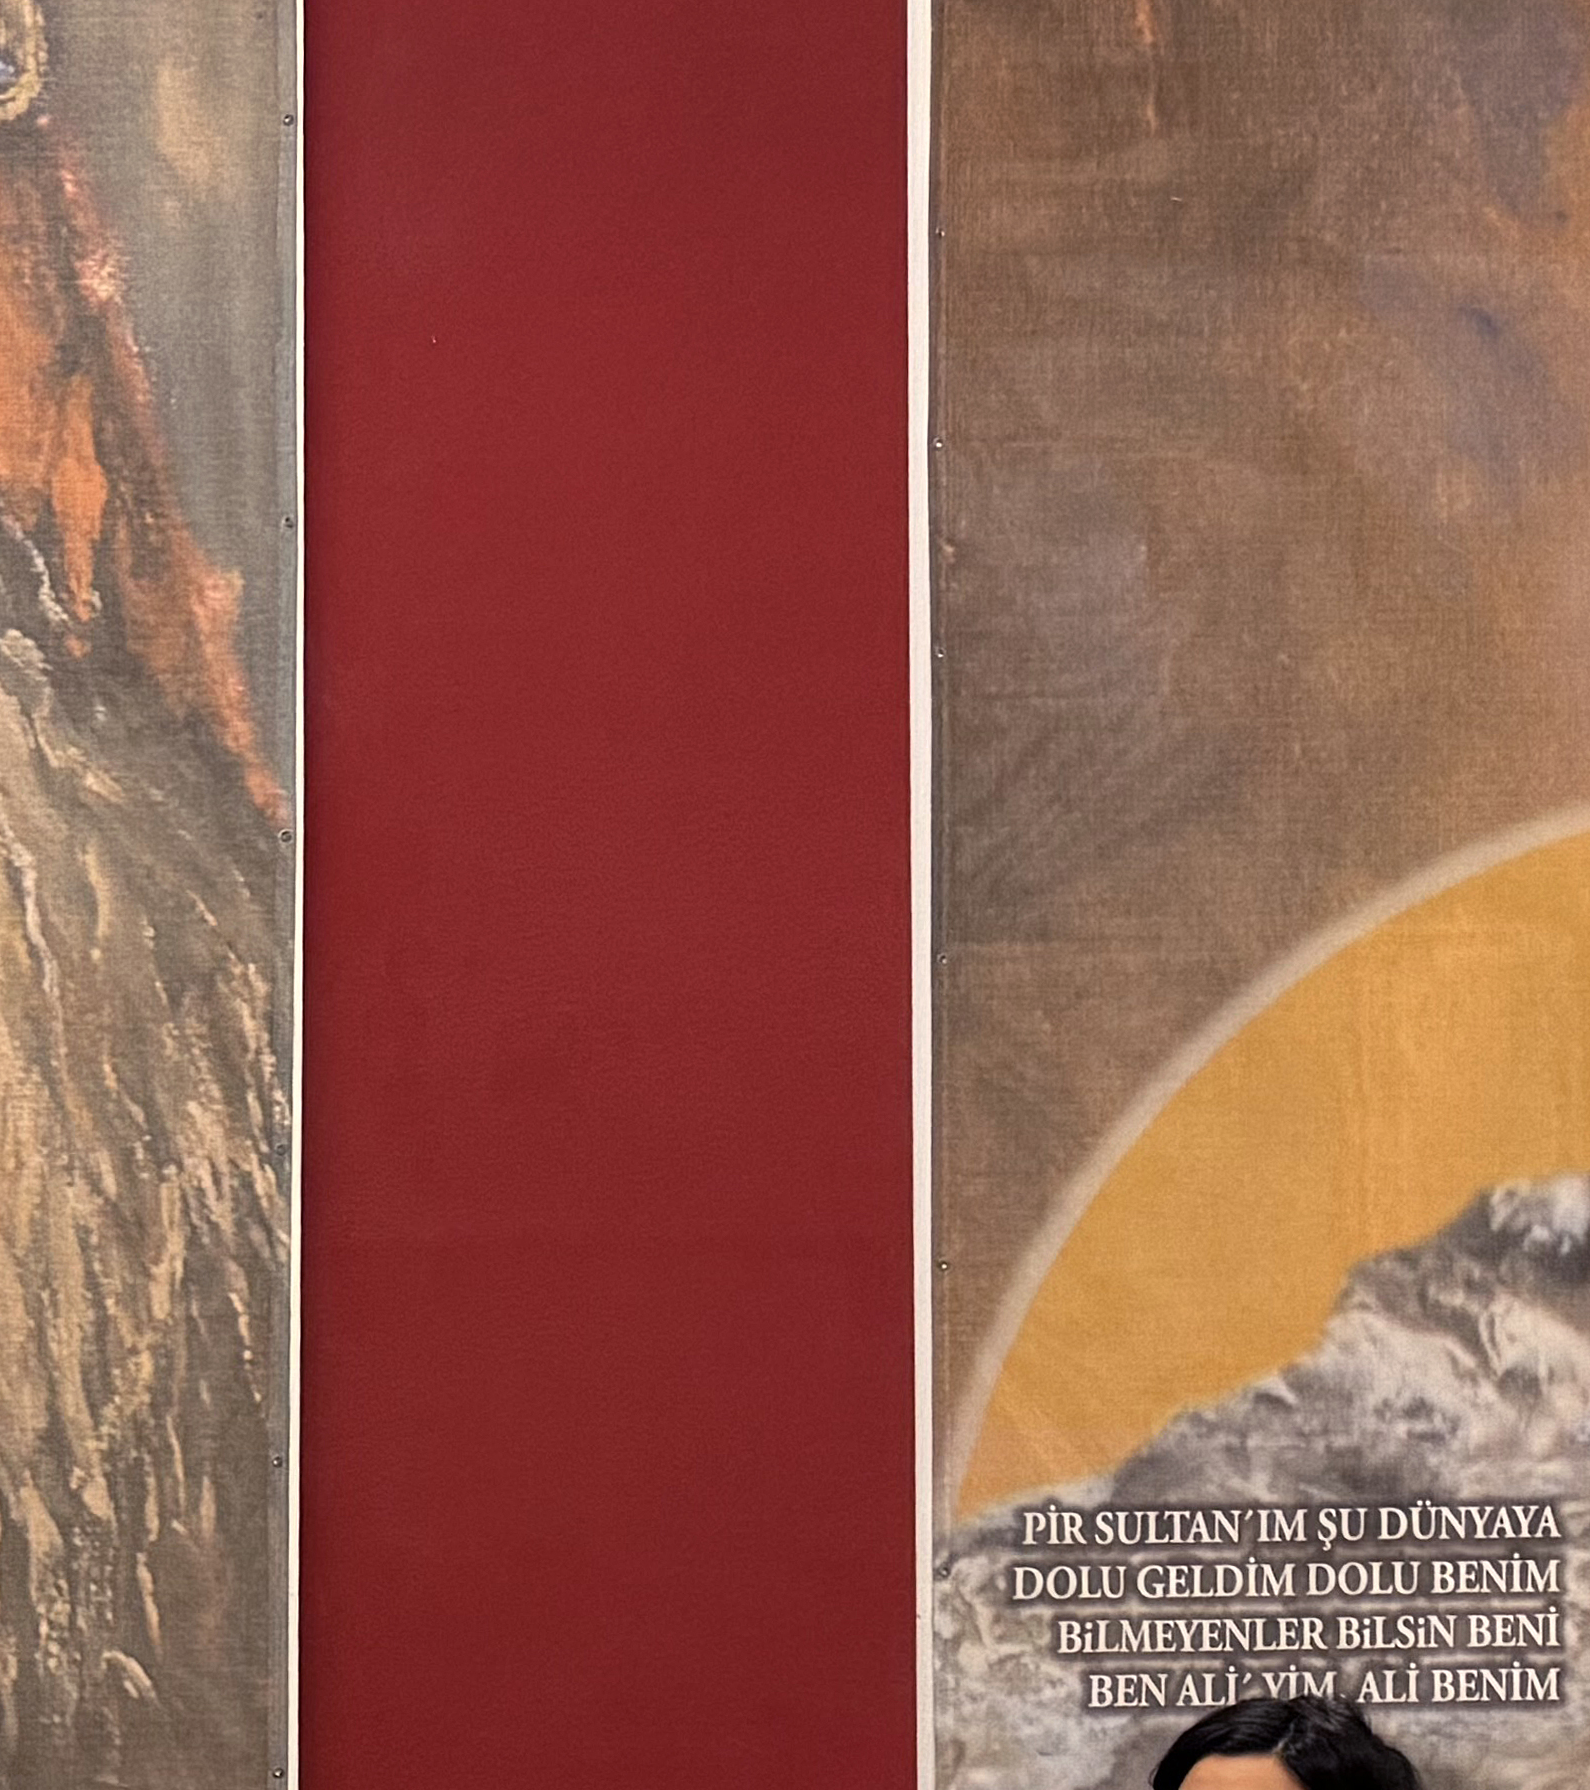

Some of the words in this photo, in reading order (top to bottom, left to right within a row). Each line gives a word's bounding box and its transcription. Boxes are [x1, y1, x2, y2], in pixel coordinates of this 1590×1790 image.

[1023, 1504, 1087, 1546] PİR
[1318, 1507, 1366, 1552] ŞU
[1378, 1500, 1561, 1541] DÜNYAYA
[1013, 1566, 1126, 1601] DOLU
[1137, 1556, 1296, 1598] GELDİM
[1307, 1561, 1420, 1597] DOLU
[1432, 1553, 1560, 1595] BENİM
[1469, 1606, 1560, 1648] BENİ
[1089, 1675, 1167, 1708] BEN
[1357, 1662, 1420, 1704] ALİ
[1432, 1660, 1560, 1703] BENİM
